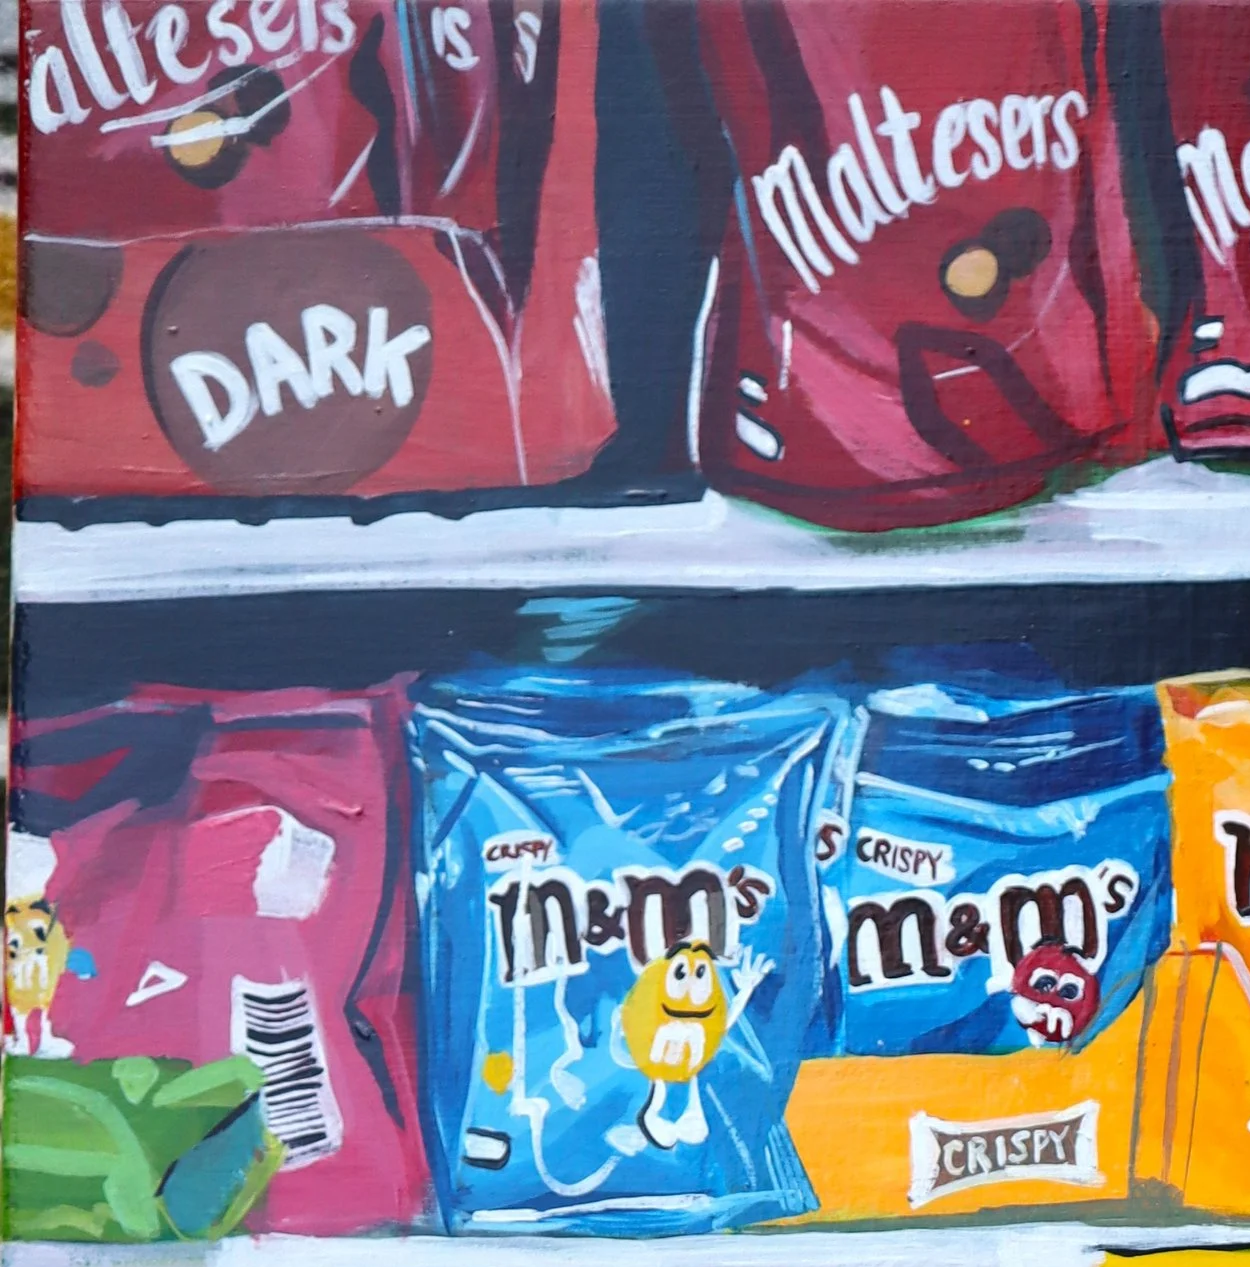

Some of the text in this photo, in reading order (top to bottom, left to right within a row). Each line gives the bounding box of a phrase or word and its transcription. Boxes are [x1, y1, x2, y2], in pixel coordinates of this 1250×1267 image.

[752, 86, 1089, 294] Maltesers
[170, 304, 432, 451] DARK
[855, 836, 943, 881] CRISPY
[942, 1127, 1070, 1177] CRISPY
